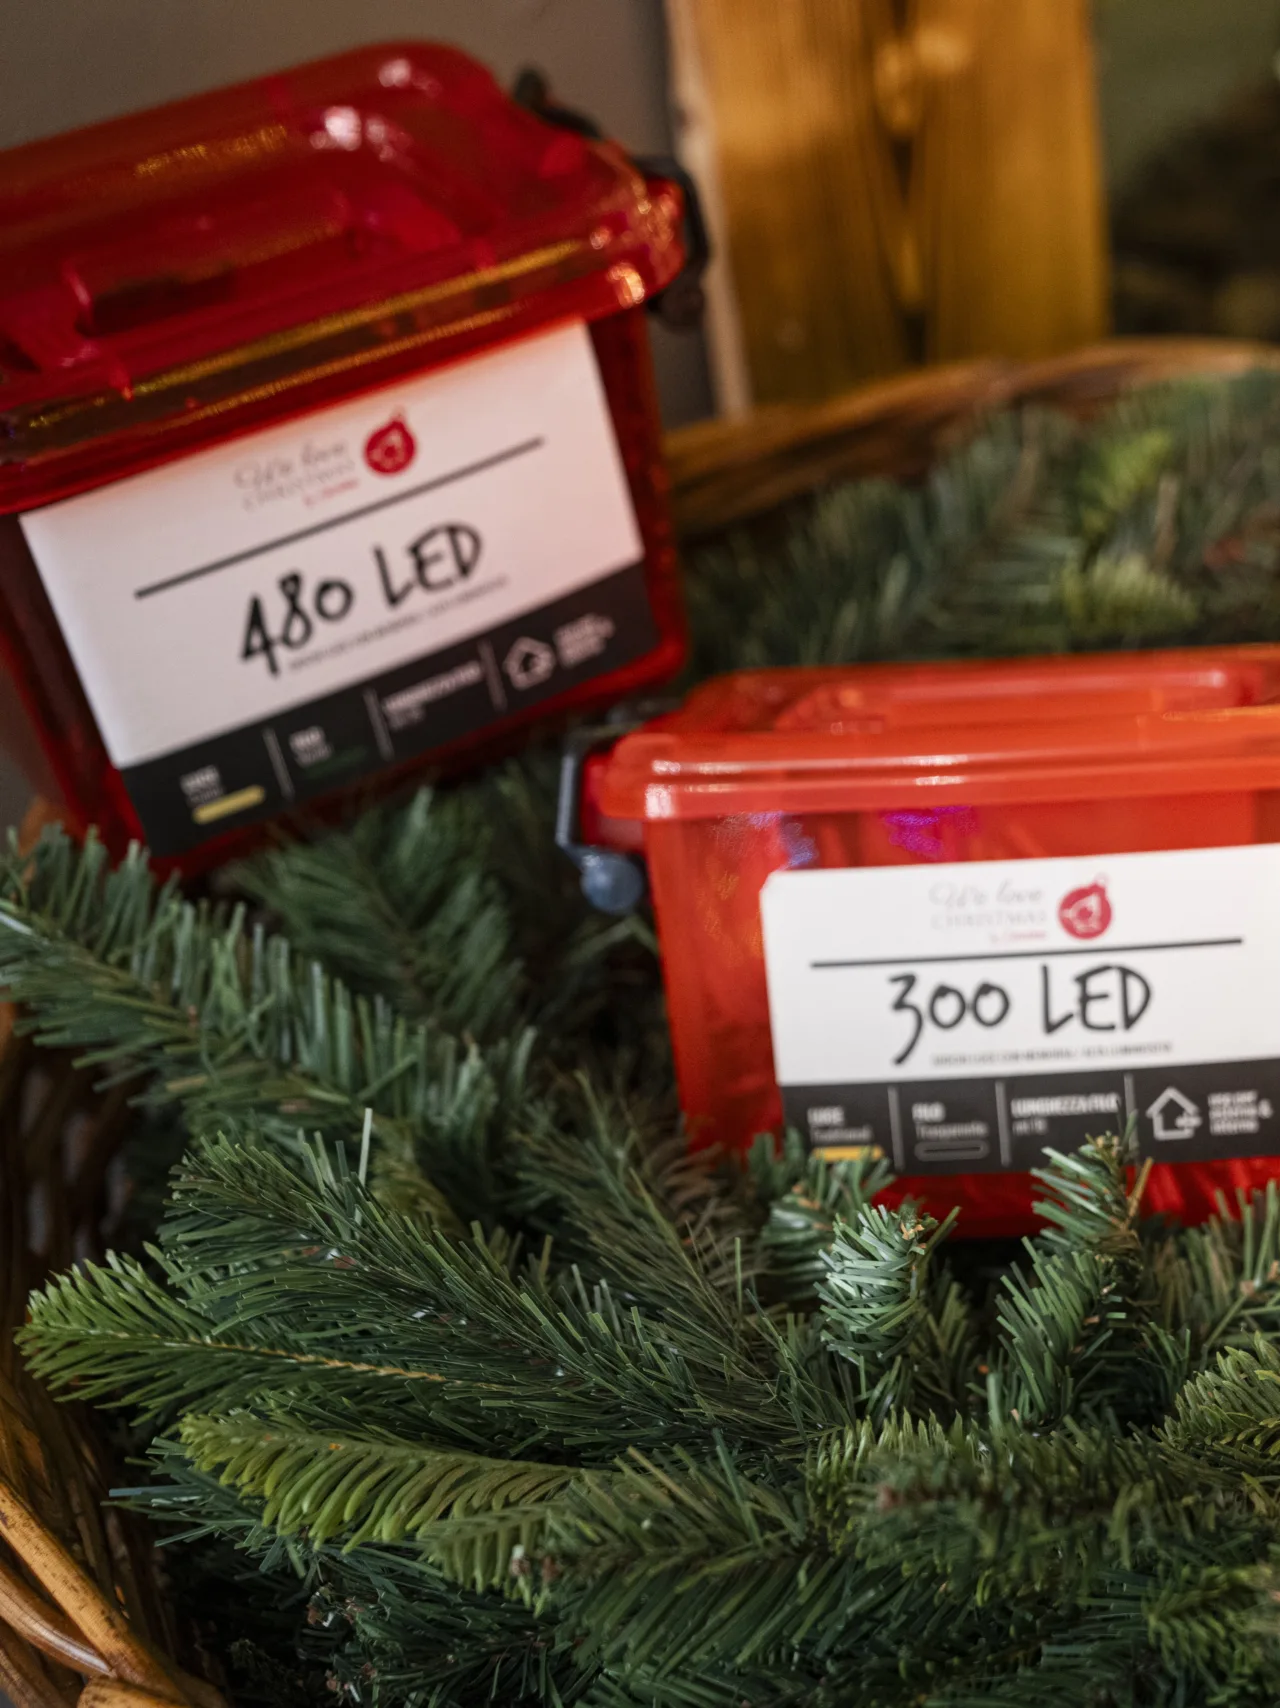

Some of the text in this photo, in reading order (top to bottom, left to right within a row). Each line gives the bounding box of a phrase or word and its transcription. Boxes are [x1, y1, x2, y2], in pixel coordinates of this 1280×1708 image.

[241, 569, 354, 677] 480
[371, 522, 482, 607] LED
[888, 963, 1151, 1065] 300 LED
